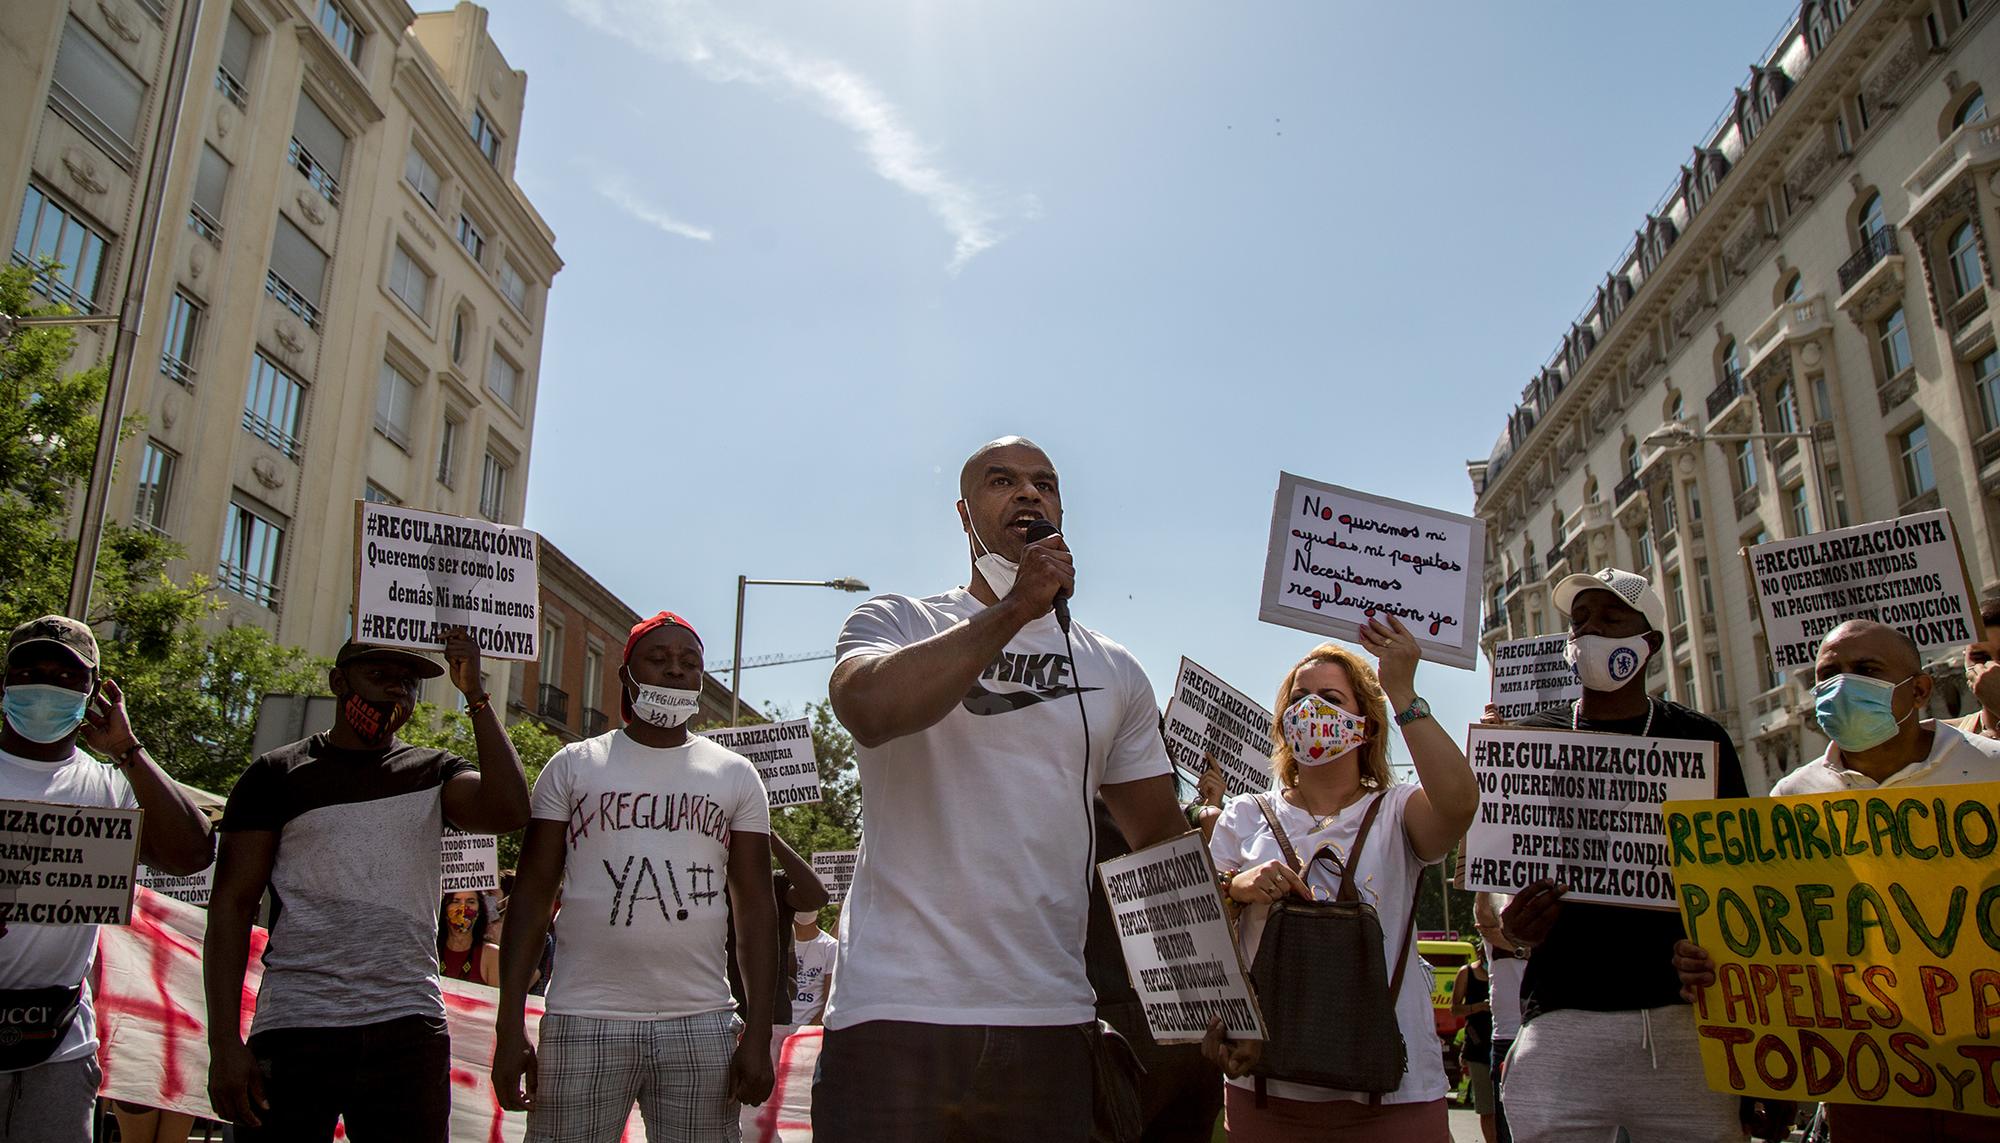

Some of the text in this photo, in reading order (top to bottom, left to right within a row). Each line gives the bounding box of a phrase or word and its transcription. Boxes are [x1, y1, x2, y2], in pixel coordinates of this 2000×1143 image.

[367, 512, 533, 561] #REGULARIZACIÓNYA
[1303, 496, 1447, 542] No queremos ni
[368, 541, 515, 582] Queremos ser como los
[1364, 544, 1385, 557] ni
[1389, 550, 1461, 575] paguitas
[1755, 519, 1947, 577] #REGULARIZACIÓNYA
[1293, 549, 1402, 590] Necesitamos
[1761, 552, 1918, 596] NO QUEREMOS NI AYUDAS
[389, 580, 535, 619] demás Ni más ni menos
[1288, 582, 1458, 636] regularizacion ya
[1772, 573, 1942, 618] NI PAGUITAS NECESITAMOS
[1881, 592, 1962, 626] CONDICIÓN
[982, 652, 1072, 690] NIKE
[1495, 667, 1506, 678] LA
[1506, 665, 1521, 676] LEY
[1523, 663, 1534, 675] DE
[1500, 680, 1522, 693] MATA
[1523, 680, 1529, 690] A
[1530, 676, 1572, 690] PERSONAS
[1204, 701, 1219, 723] SER
[1218, 711, 1246, 740] HUMANO
[1244, 728, 1254, 746] ES
[1205, 722, 1244, 757] POR FAVOR
[1310, 722, 1340, 738] PEACE
[779, 764, 801, 777] CADA
[802, 761, 817, 773] DIA
[1169, 718, 1270, 790] PAPELES PARA TODOS Y TODAS
[1475, 740, 1706, 779] #REGULARIZACIÓNYA
[1477, 772, 1667, 804] NO QUEREMOS NI AYUDAS
[1481, 802, 1499, 823] NI
[1501, 803, 1574, 828] PAGUITAS
[446, 858, 485, 874] CONDICIÓN
[1512, 834, 1579, 859] PAPELES
[1583, 838, 1608, 862] SIN
[45, 872, 93, 889] CADA
[97, 874, 128, 889] DIA
[166, 873, 207, 887] CONDICIÓN
[442, 873, 495, 890] IZACIÓNYA
[1108, 847, 1210, 906] #REGULARIZACIÓNYA
[1118, 908, 1149, 937] PAPELES
[1144, 905, 1168, 932] PARA
[1161, 900, 1190, 929] TODOS
[1190, 893, 1221, 924] TODAS
[1153, 931, 1197, 961] POR FAVOR
[1140, 953, 1230, 992] PAPELES SIN CONDICIÓN
[1699, 1024, 1936, 1102] TODOS
